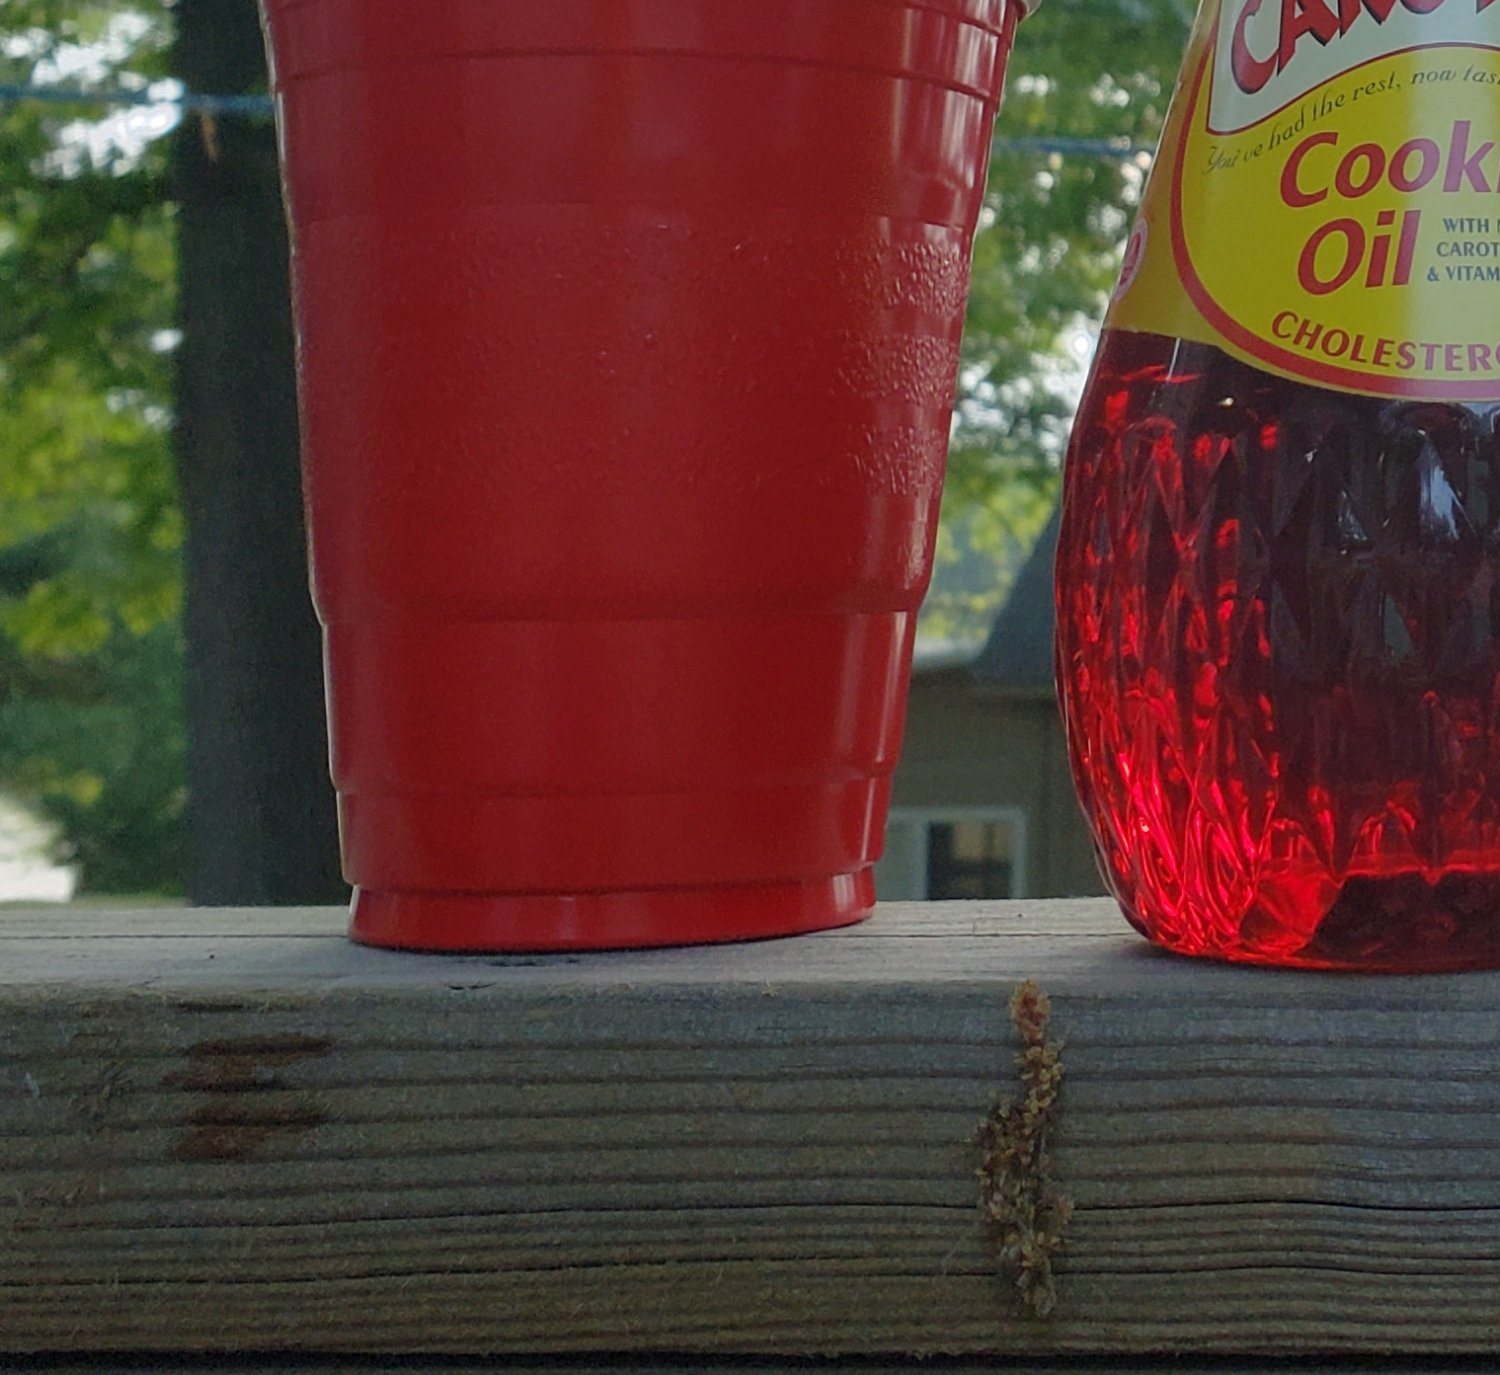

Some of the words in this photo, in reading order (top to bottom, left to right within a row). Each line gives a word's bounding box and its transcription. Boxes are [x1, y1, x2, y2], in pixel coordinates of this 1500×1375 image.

[1202, 144, 1263, 173] You've
[1268, 108, 1305, 150] had
[1312, 89, 1346, 121] the
[1352, 71, 1402, 101] rest,
[1411, 69, 1456, 85] now
[1442, 217, 1490, 234] WITH
[1297, 209, 1422, 295] Oil
[1427, 266, 1440, 283] &
